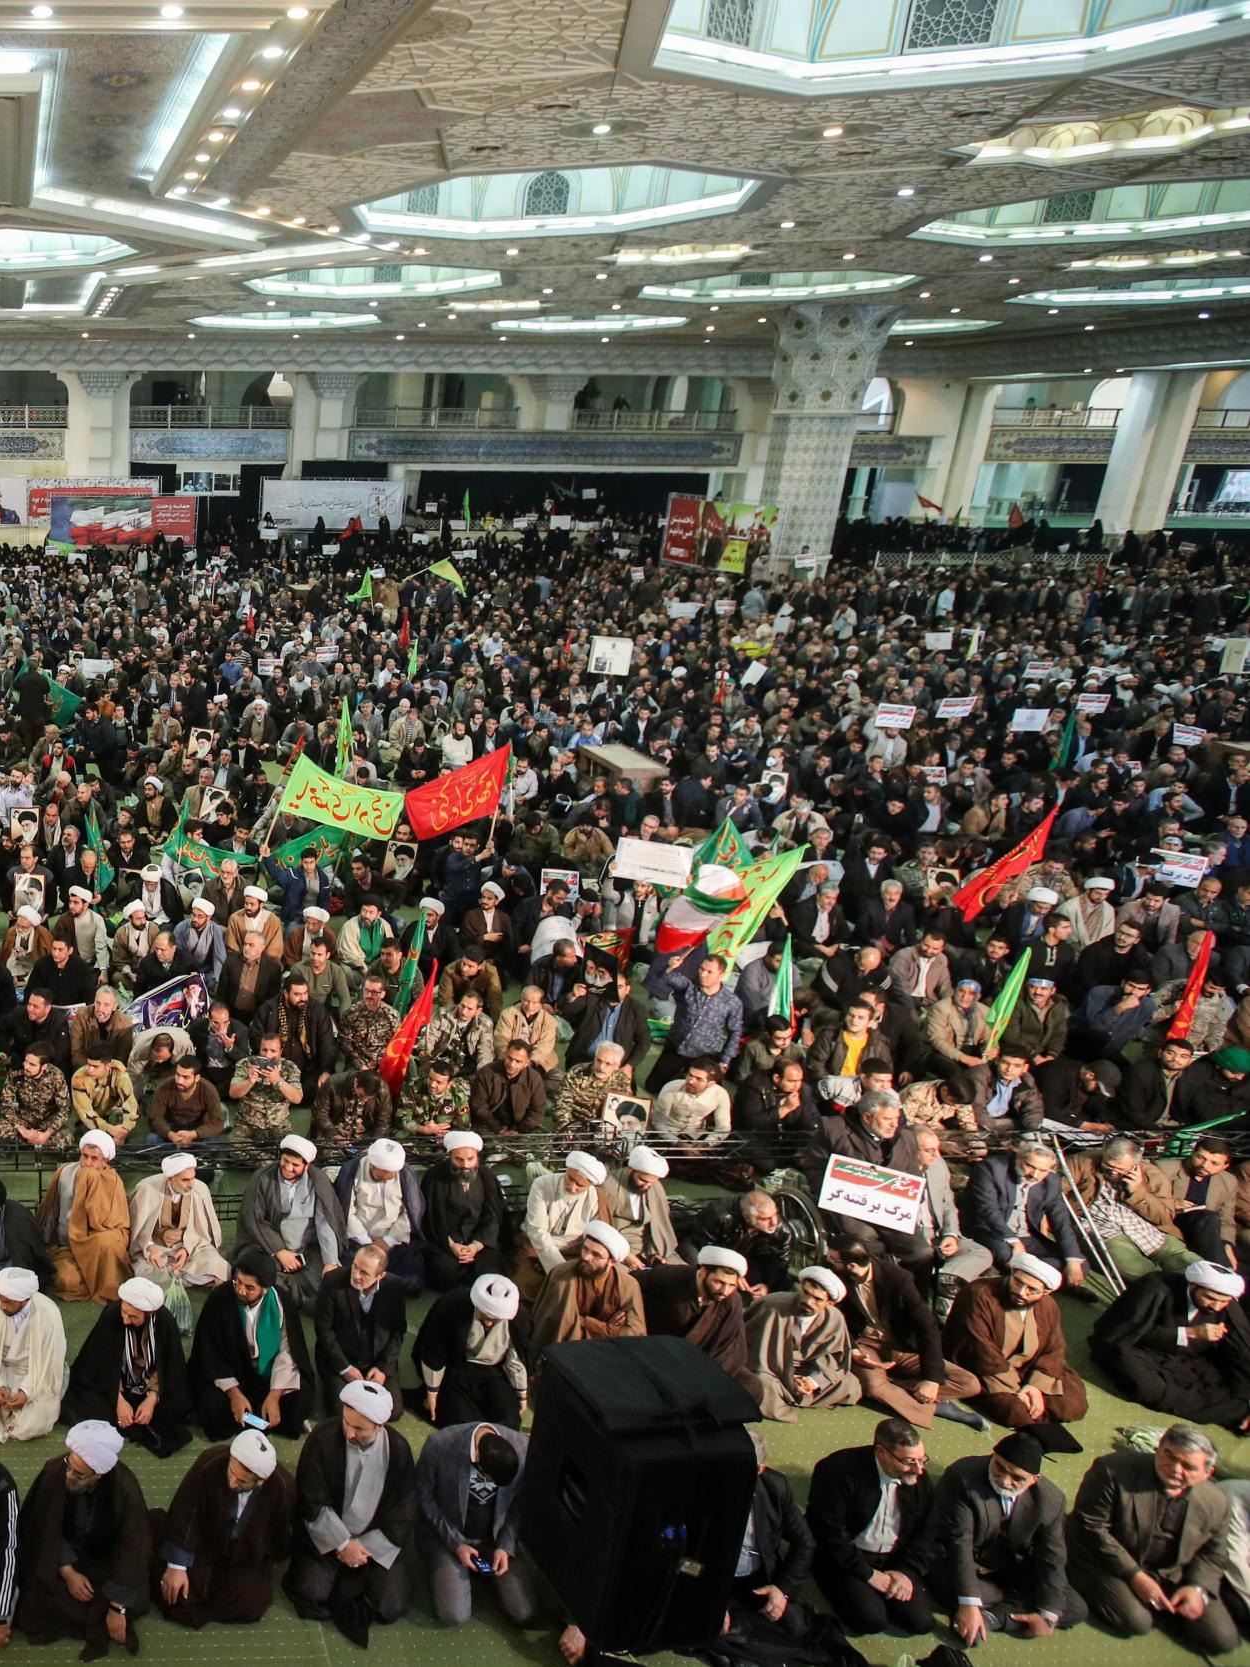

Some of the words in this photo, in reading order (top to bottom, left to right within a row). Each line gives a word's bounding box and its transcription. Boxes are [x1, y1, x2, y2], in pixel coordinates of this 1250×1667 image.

[826, 1189, 844, 1202] گر
[843, 1192, 868, 1206] فتنه
[868, 1202, 881, 1214] بر
[884, 1205, 913, 1222] مرگ
